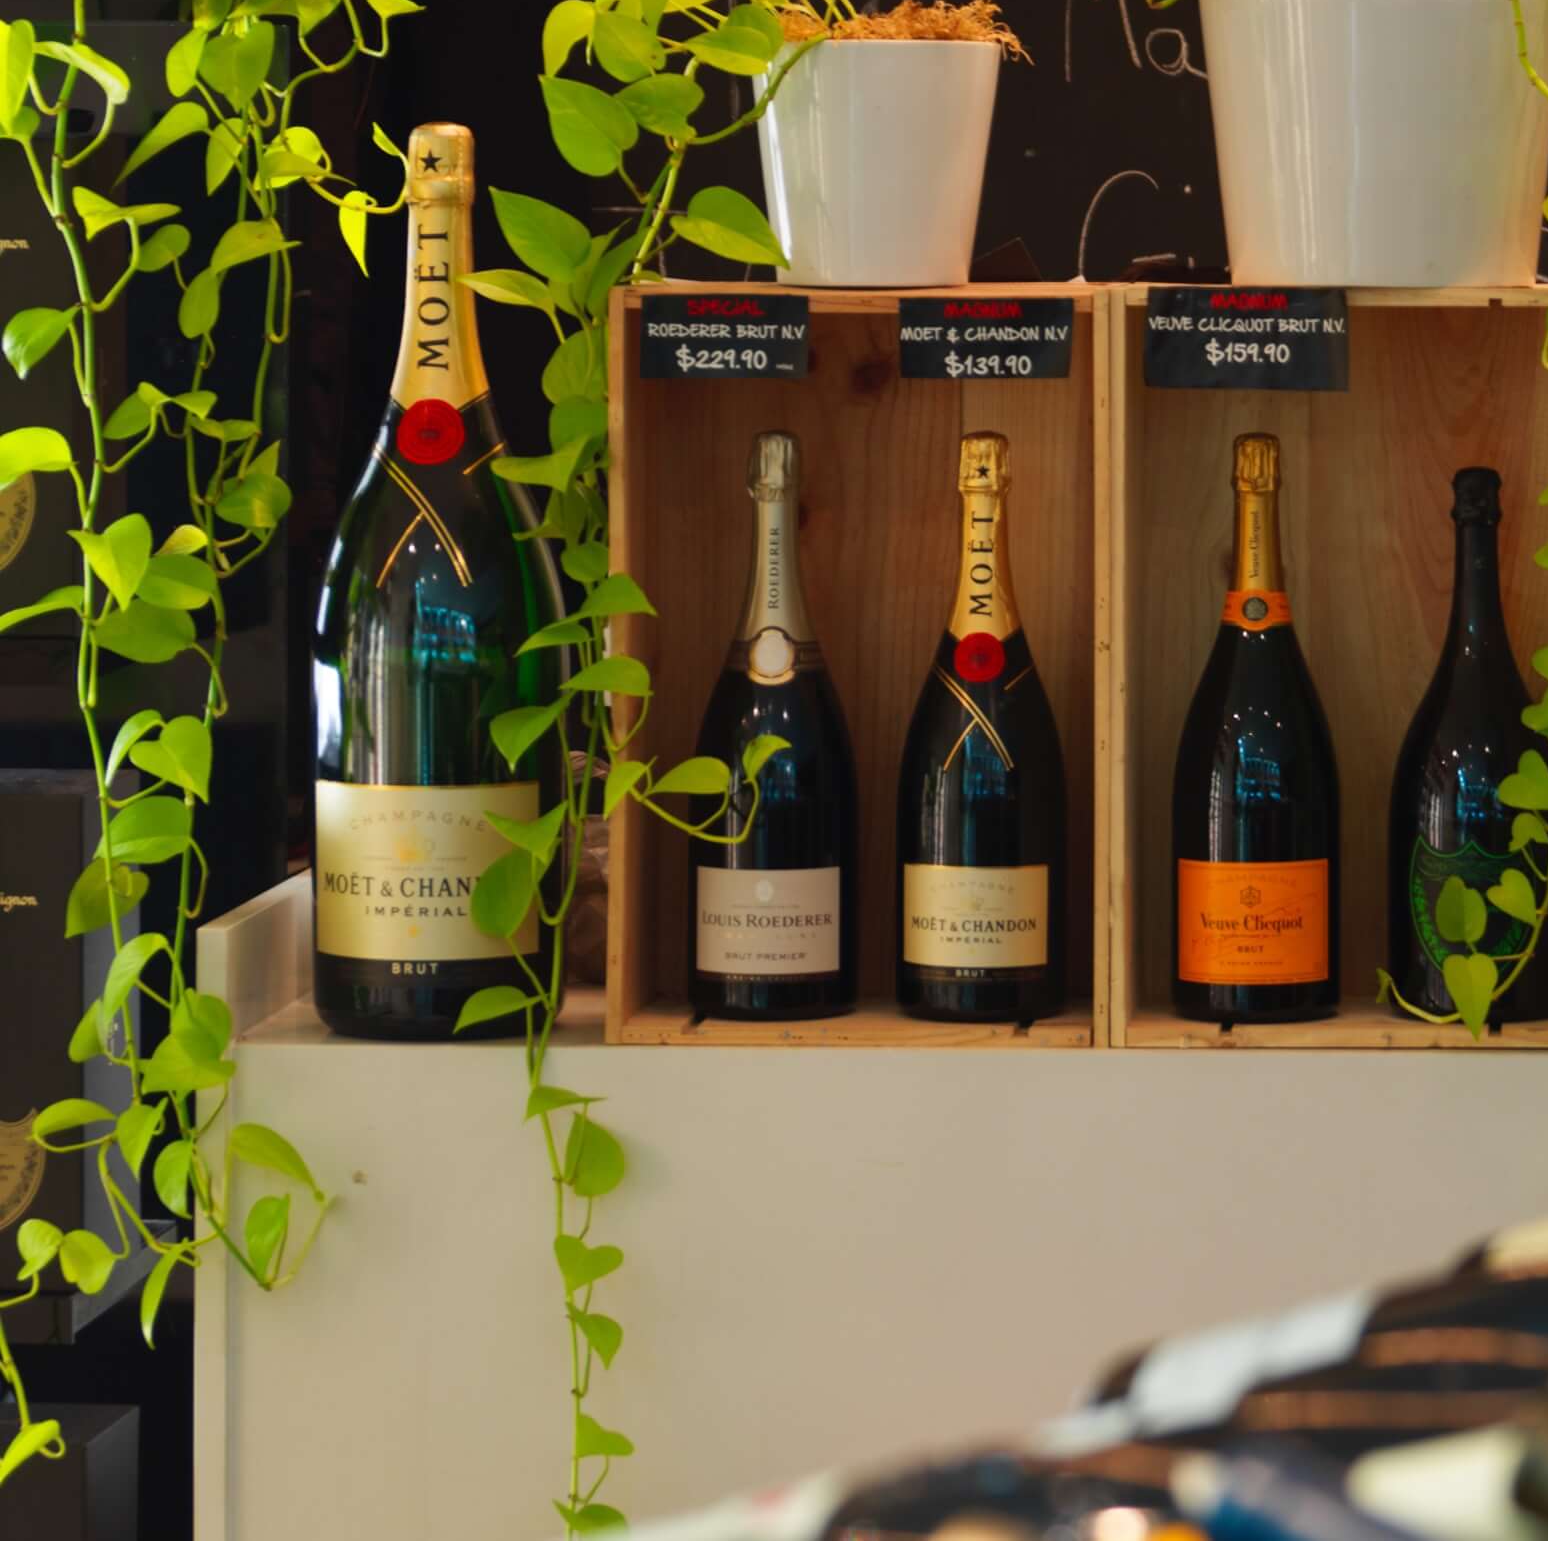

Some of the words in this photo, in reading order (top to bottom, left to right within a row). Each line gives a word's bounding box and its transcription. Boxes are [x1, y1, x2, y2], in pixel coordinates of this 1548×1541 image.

[413, 222, 450, 371] MOËT
[647, 322, 733, 339] ROEDERER
[735, 323, 779, 340] BRUT
[899, 325, 945, 342] MOET
[963, 325, 1041, 342] CHANDON
[1148, 314, 1194, 331] VEUVE
[1197, 316, 1275, 334] CLICQUOT
[1276, 317, 1321, 334] BRUT
[674, 342, 768, 373] $229.90
[1203, 336, 1291, 367] $159.90
[943, 348, 1033, 378] $139.90
[967, 510, 994, 618] MOËT
[323, 869, 375, 897] MOËT
[380, 879, 393, 898] &
[399, 875, 480, 898] CHAN
[702, 908, 742, 928] LOUIS
[745, 913, 833, 929] ROEDERER
[910, 915, 947, 931] MOËT
[949, 921, 959, 932] &
[961, 917, 1037, 933] CHANDON
[1199, 913, 1240, 931] Veuve
[1243, 914, 1304, 934] Clicquot
[391, 961, 440, 975] BRUT
[955, 968, 987, 978] BRUT
